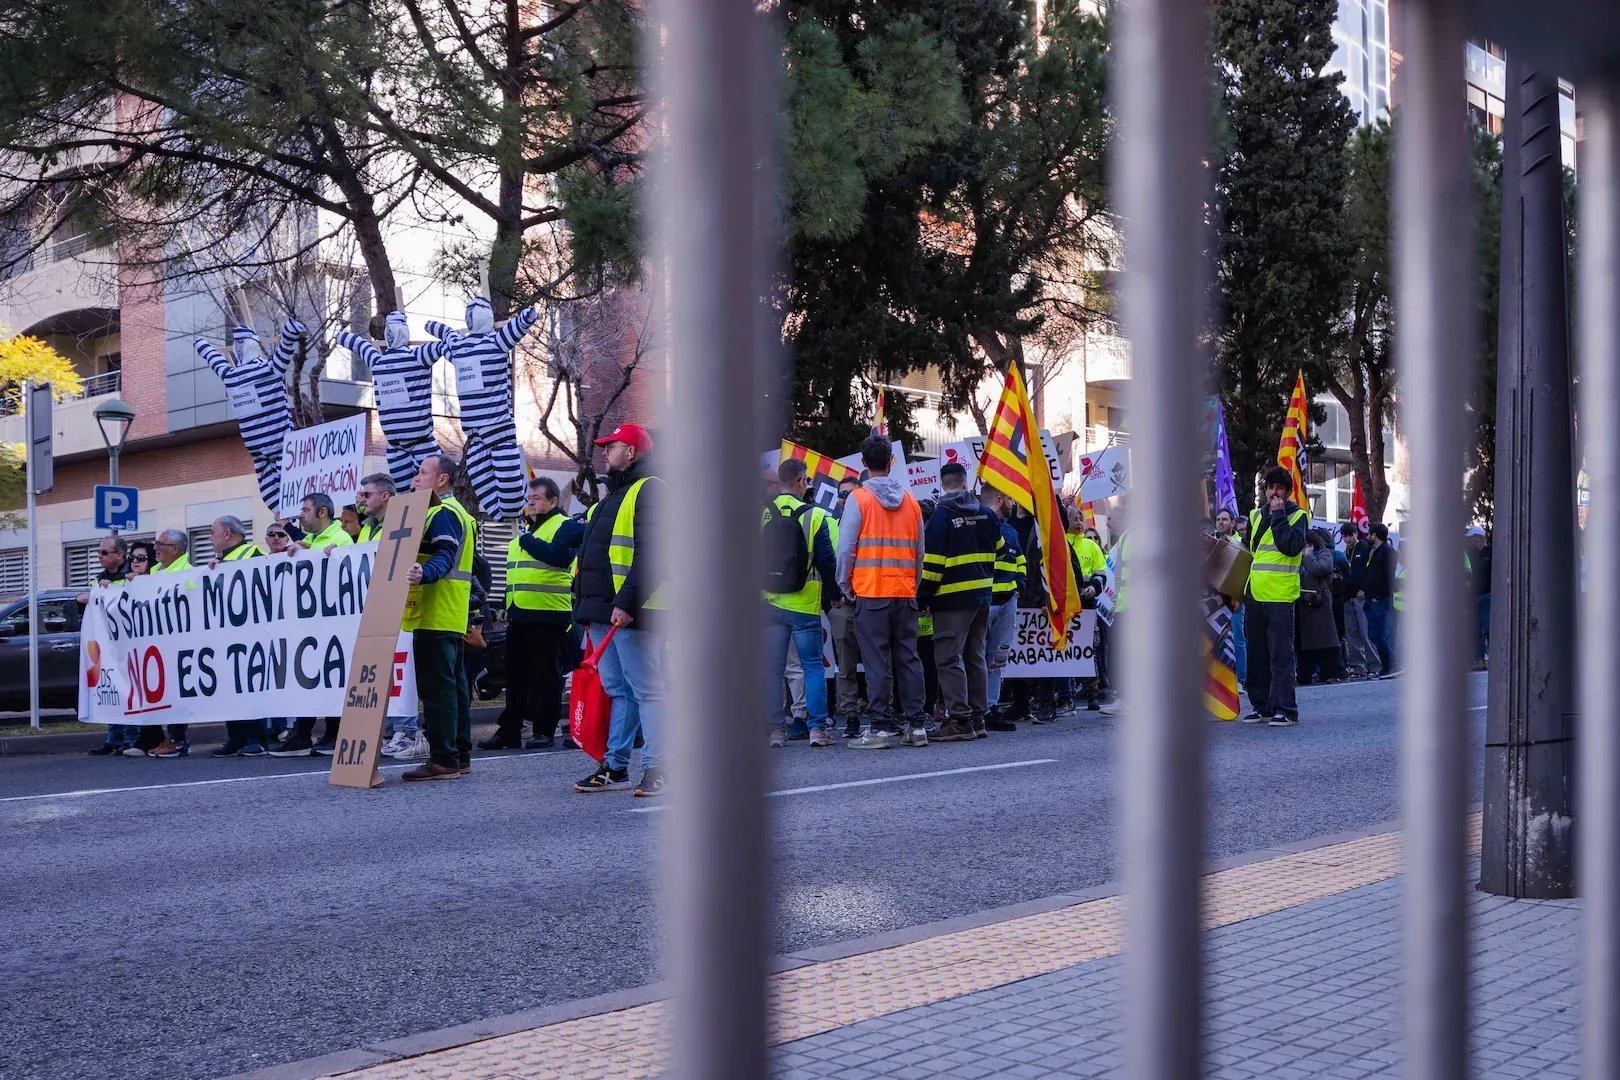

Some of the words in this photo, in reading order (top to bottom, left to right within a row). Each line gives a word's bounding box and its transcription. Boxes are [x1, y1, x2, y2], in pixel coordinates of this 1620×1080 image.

[285, 439, 298, 471] SI
[299, 434, 319, 467] HAY
[319, 422, 358, 460] OPCIÓN
[915, 466, 925, 474] AL
[281, 478, 303, 510] HAY
[104, 491, 129, 524] P
[118, 583, 191, 640] Smith
[1017, 630, 1074, 646] SEGUR
[1007, 645, 1096, 666] RABAJANDO
[100, 668, 114, 689] DS
[127, 645, 165, 711] NO
[178, 647, 217, 697] ES
[359, 664, 378, 684] DS
[97, 685, 120, 706] Smith
[346, 686, 378, 709] Smith
